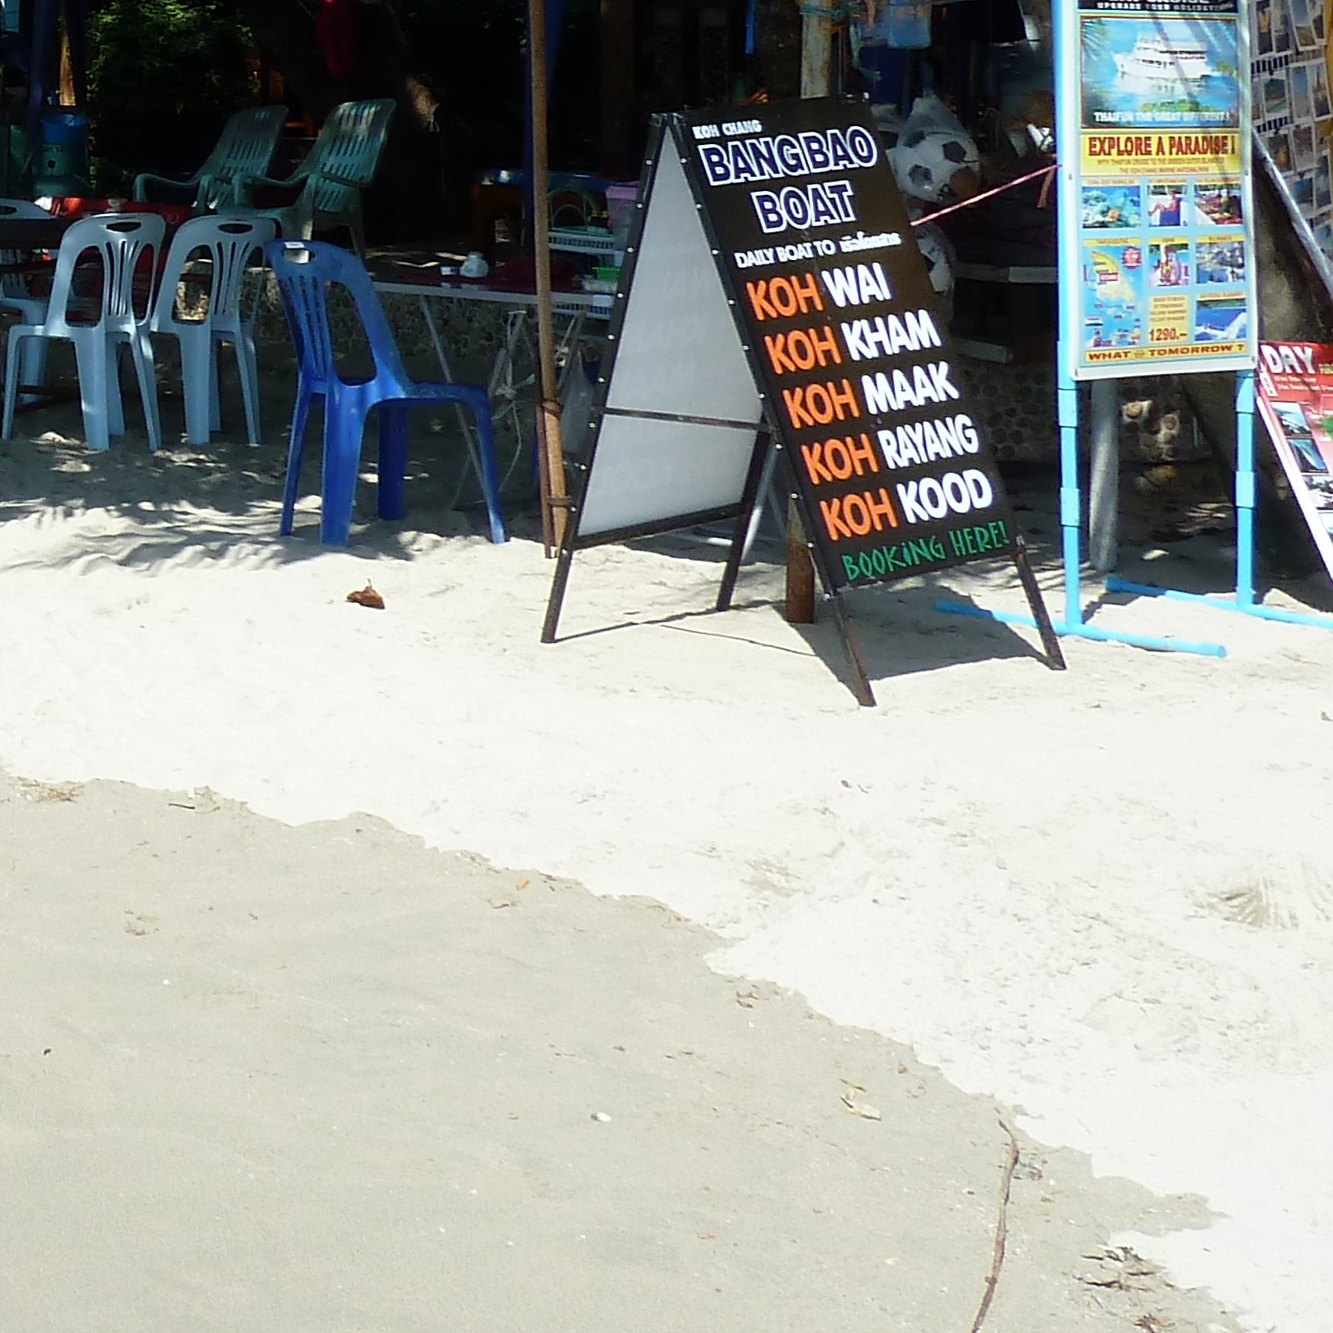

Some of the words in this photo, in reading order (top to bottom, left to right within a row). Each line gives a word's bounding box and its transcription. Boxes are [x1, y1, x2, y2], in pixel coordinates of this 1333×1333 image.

[692, 124, 721, 140] KOH
[722, 120, 763, 137] CHANG
[1088, 136, 1152, 156] EXPLORE
[1155, 136, 1166, 156] A
[1169, 135, 1228, 156] PARADISE
[751, 180, 856, 233] BOAT
[735, 248, 776, 268] DAILY
[776, 242, 814, 263] BOAT
[813, 240, 836, 257] TO
[746, 272, 824, 321] KOH
[821, 262, 893, 308] WAI
[764, 325, 842, 375] KOH
[841, 309, 942, 361] KHAM
[1088, 350, 1132, 361] WHAT
[1149, 344, 1233, 357] TOMORROW
[1260, 344, 1316, 374] DAY
[783, 378, 861, 429] KOH
[861, 361, 960, 415] MAAK
[801, 433, 879, 485] KOH
[877, 413, 979, 470] RAYANG
[819, 487, 898, 541] KOH
[896, 468, 993, 524] KOOD
[948, 520, 1011, 557] HERE!
